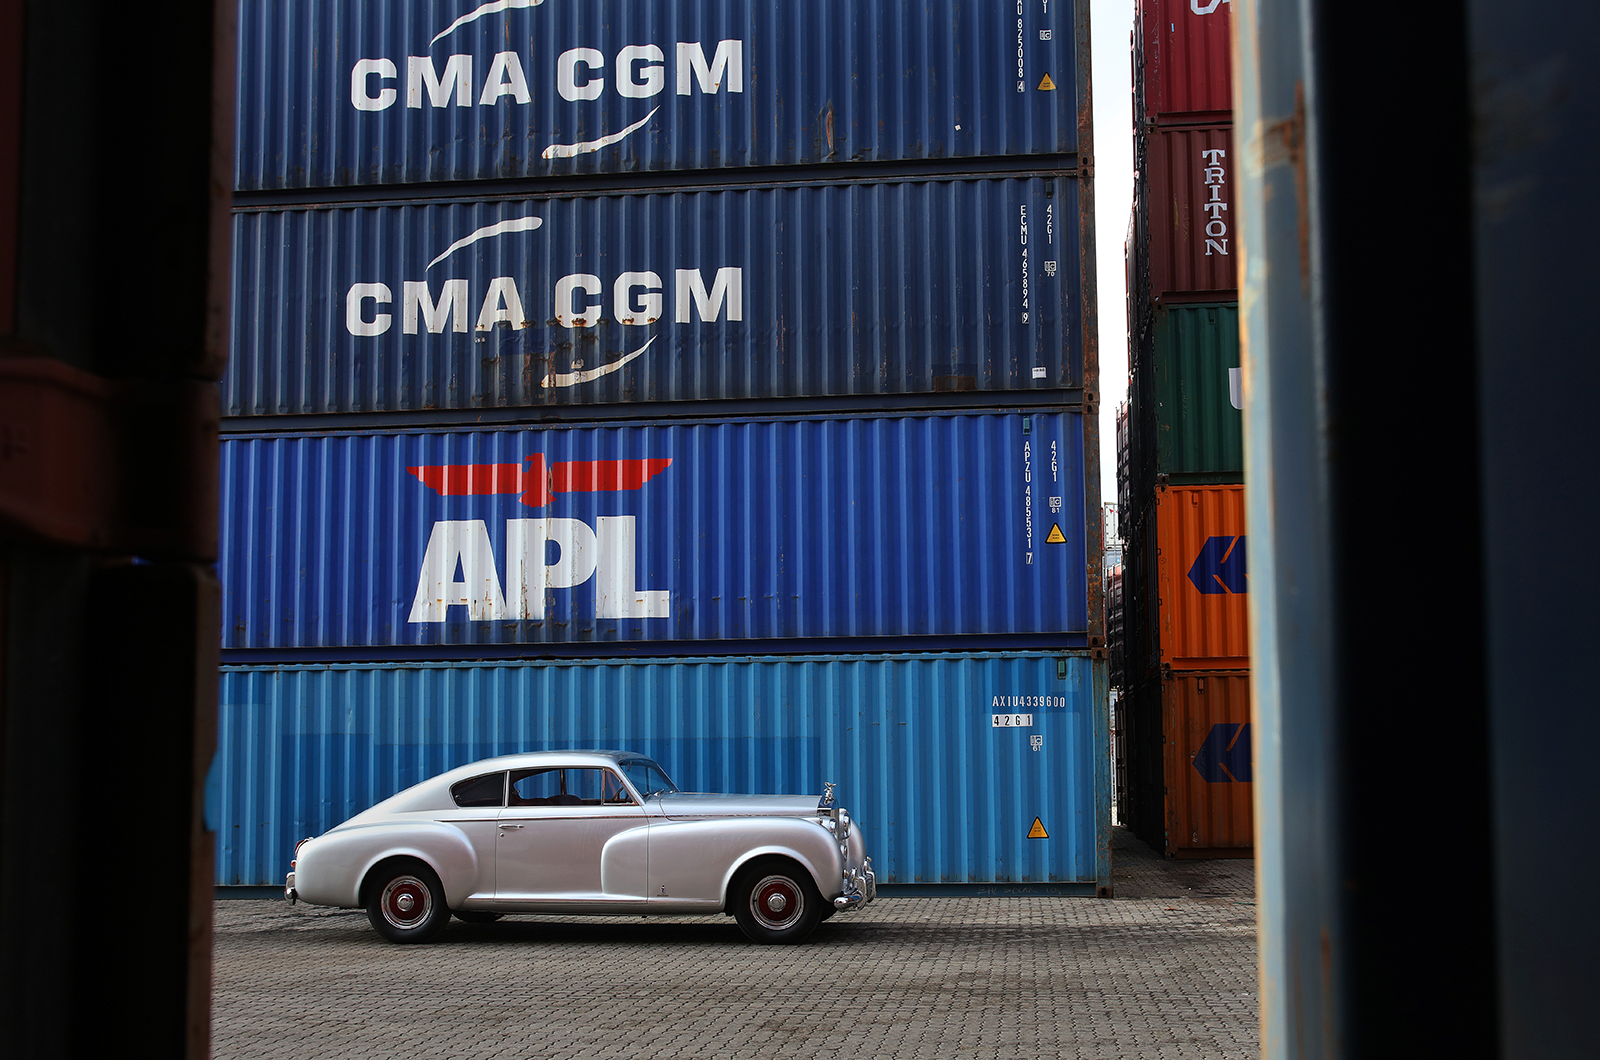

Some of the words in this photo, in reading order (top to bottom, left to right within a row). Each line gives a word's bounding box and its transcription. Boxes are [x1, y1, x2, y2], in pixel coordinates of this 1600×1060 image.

[351, 51, 531, 112] CMA
[557, 39, 743, 102] CGM
[1202, 149, 1228, 256] TRITON
[1020, 204, 1028, 245] ECMU
[1021, 248, 1029, 309] 465894
[346, 276, 526, 338] CMA
[554, 267, 743, 328] CGM
[1022, 312, 1029, 323] 9
[1050, 440, 1058, 482] 42G1
[408, 515, 671, 623] APL
[1026, 552, 1033, 564] 7
[992, 695, 1066, 708] AXIU4339600
[993, 714, 1032, 726] 42G1
